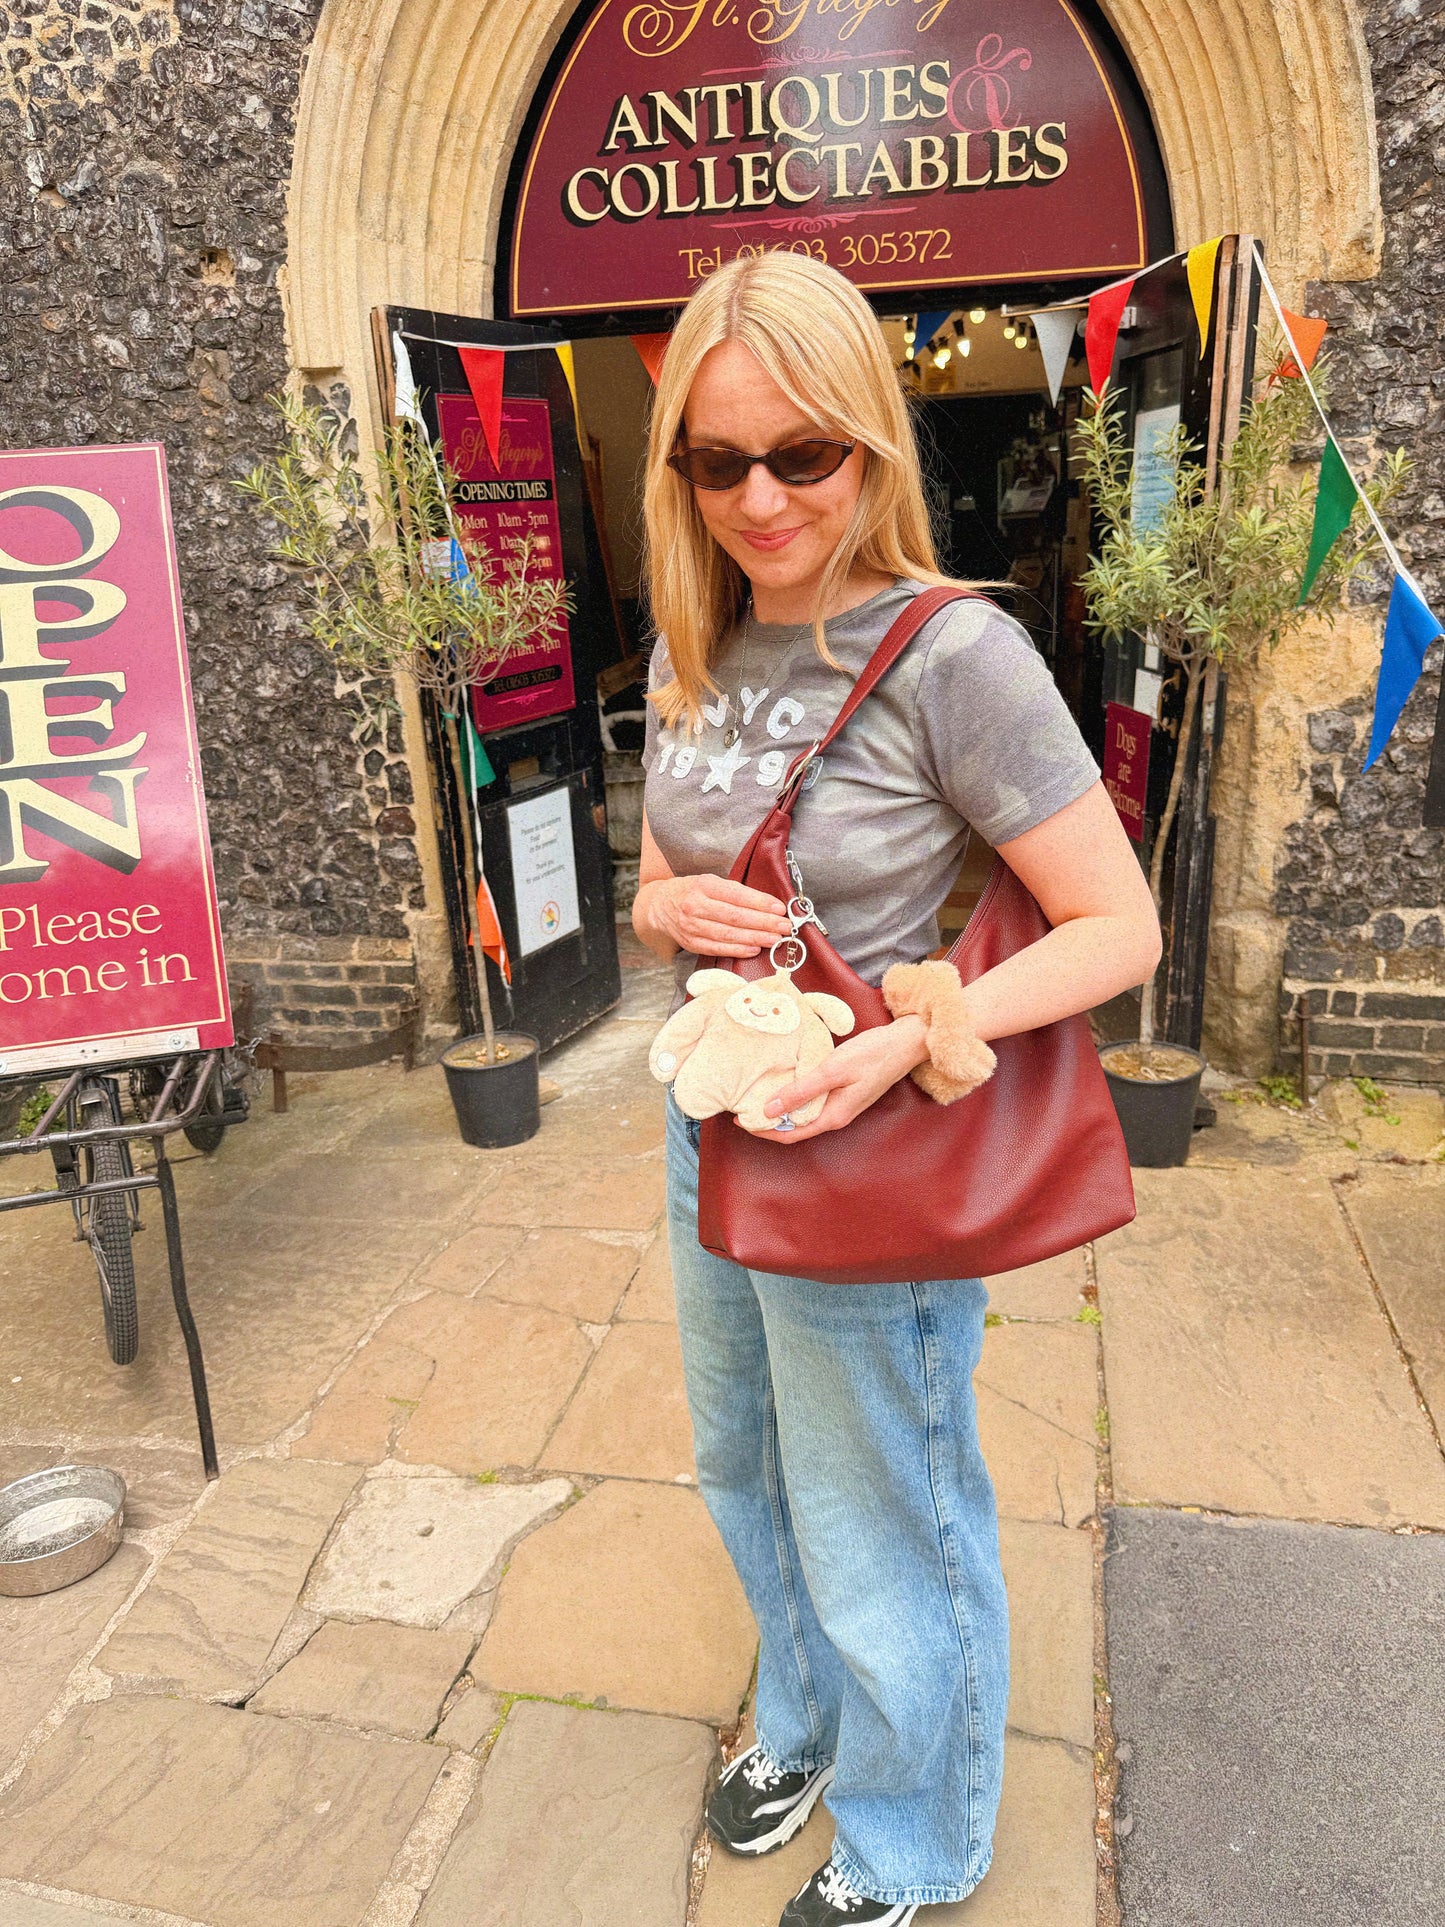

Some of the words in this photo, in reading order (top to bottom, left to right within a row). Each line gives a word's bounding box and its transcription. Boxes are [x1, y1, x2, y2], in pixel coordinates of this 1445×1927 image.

[602, 59, 950, 152] ANTIQUES
[566, 121, 1068, 223] COLLECTABLES
[837, 228, 954, 268] 305372
[460, 482, 515, 501] OPENING
[514, 481, 548, 499] TIMES
[1116, 723, 1137, 760] Dogs
[1117, 761, 1132, 784] are
[0, 903, 163, 952] Please
[136, 947, 198, 987] in
